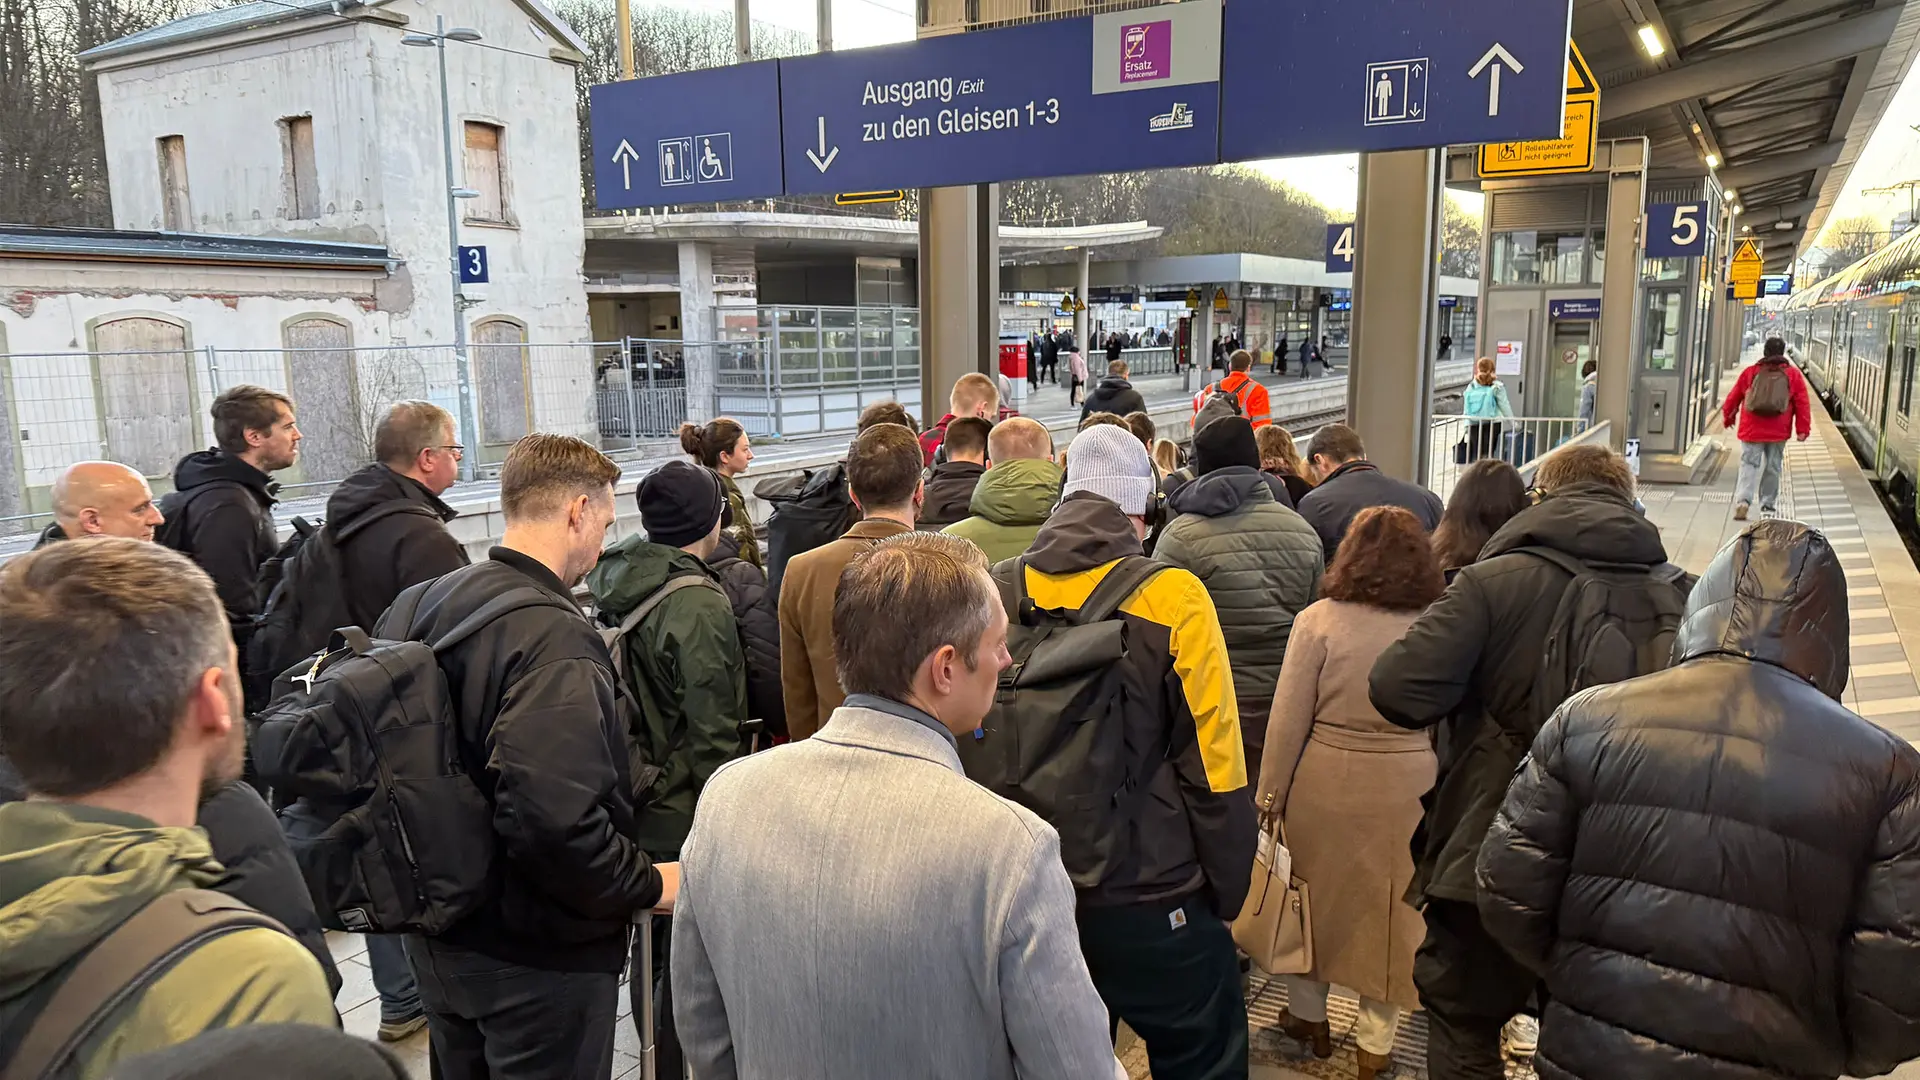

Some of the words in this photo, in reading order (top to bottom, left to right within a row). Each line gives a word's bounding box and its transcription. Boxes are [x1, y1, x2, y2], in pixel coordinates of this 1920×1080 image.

[1124, 69, 1158, 80] Replacement
[1125, 60, 1152, 72] Ersatz
[862, 77, 952, 107] Ausgang
[956, 78, 985, 96] /Exit
[862, 122, 886, 142] zu
[892, 114, 930, 139] den
[937, 106, 1019, 135] Gleisen
[1025, 98, 1060, 126] 1-3
[1524, 143, 1575, 152] Rollstuhlfahrer
[1524, 152, 1541, 160] nicht
[1542, 151, 1572, 160] geeignet
[1671, 205, 1698, 245] 5
[1332, 227, 1354, 262] 4
[468, 248, 482, 276] 3
